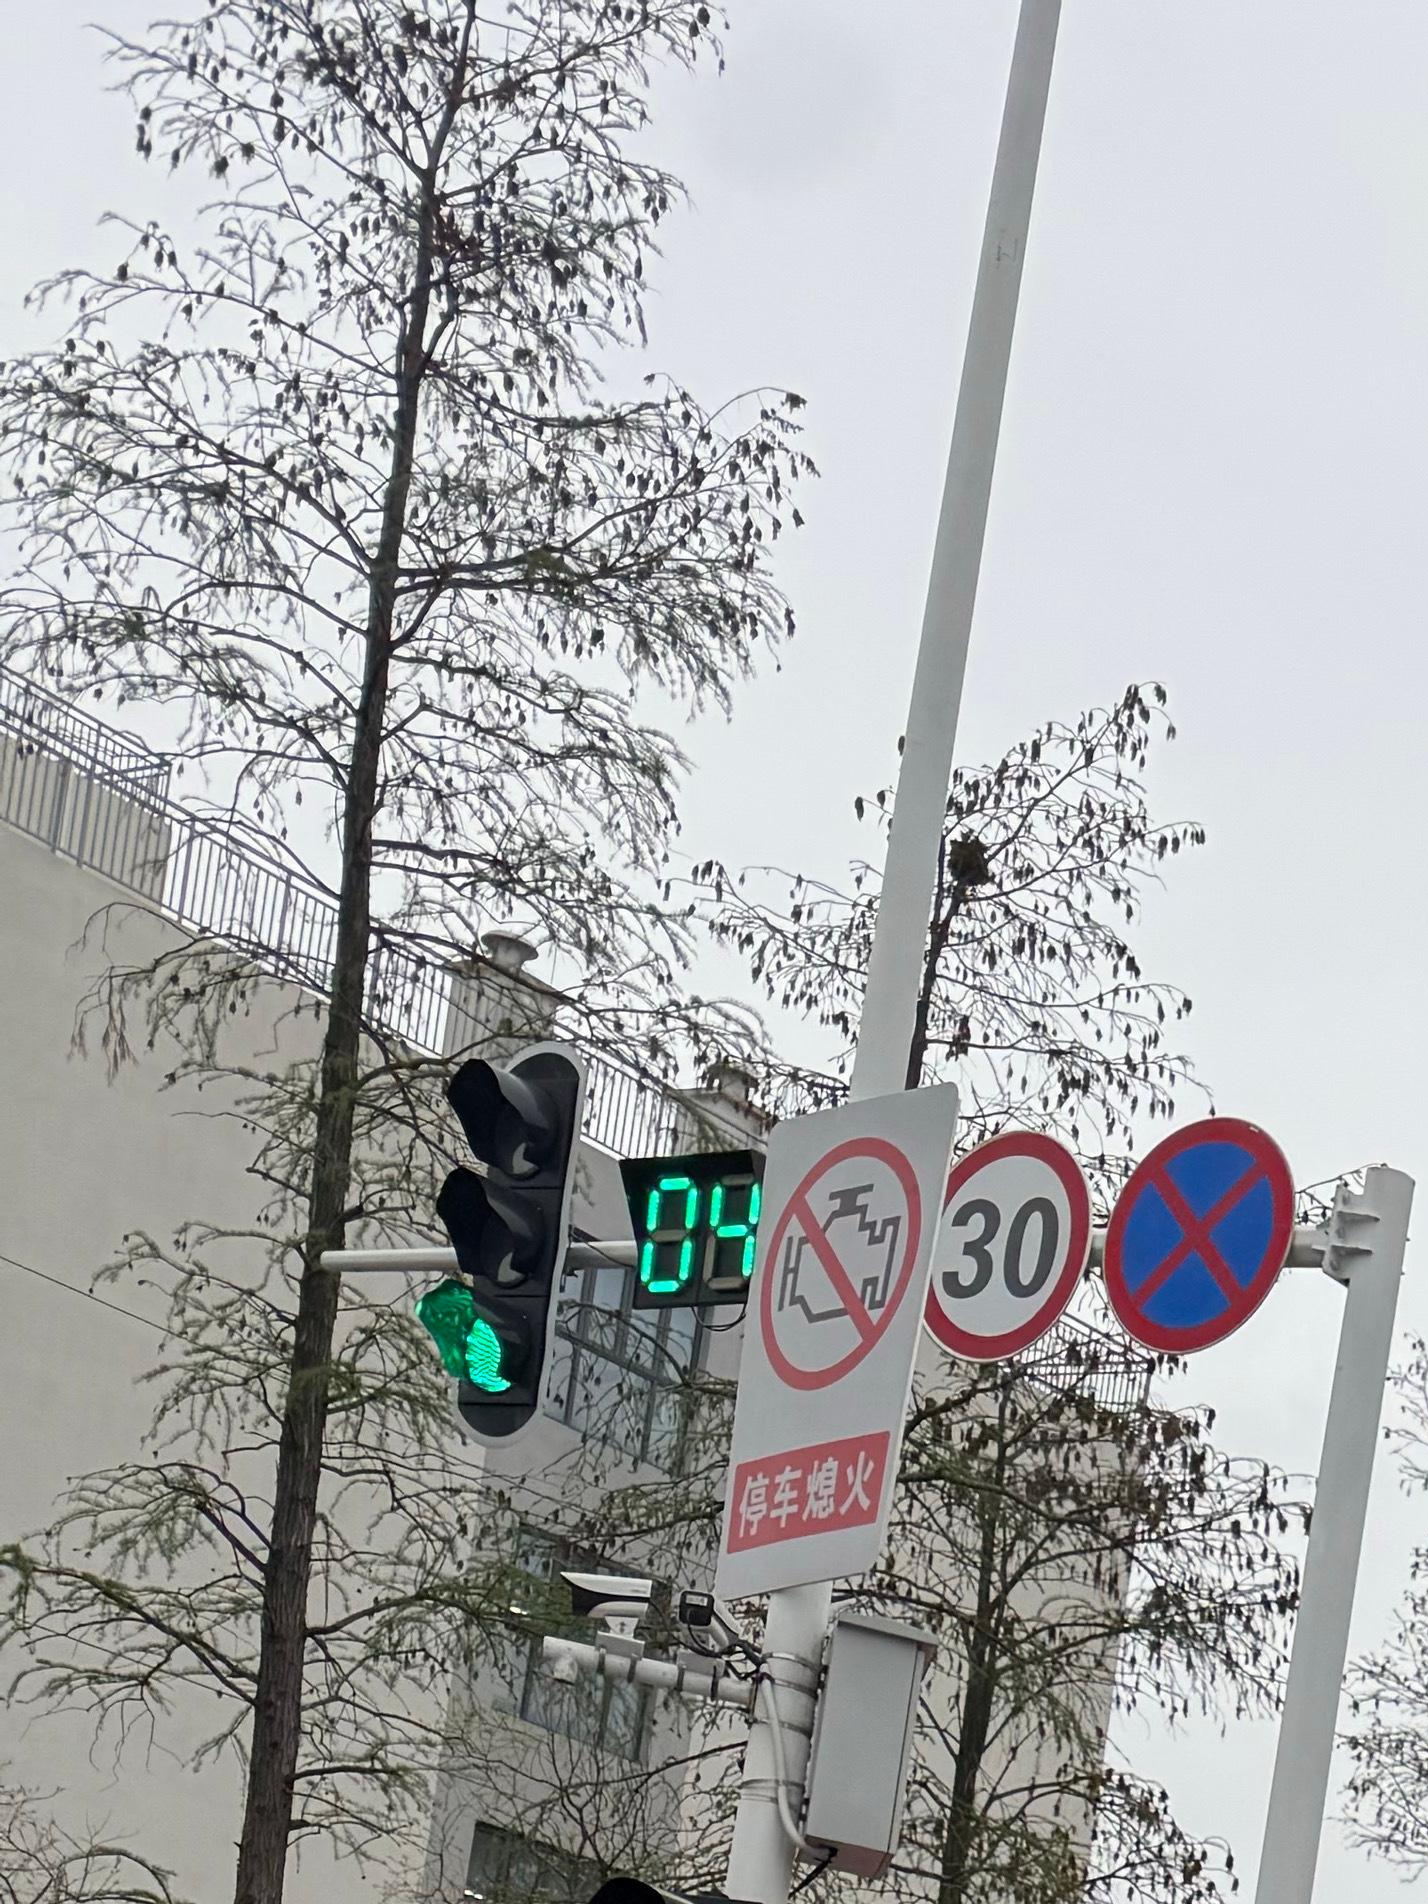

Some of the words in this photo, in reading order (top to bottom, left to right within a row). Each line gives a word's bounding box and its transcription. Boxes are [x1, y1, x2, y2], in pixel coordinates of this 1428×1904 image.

[640, 1176, 760, 1294] 04
[942, 1197, 1060, 1299] 30
[739, 1450, 876, 1539] 停车熄火
